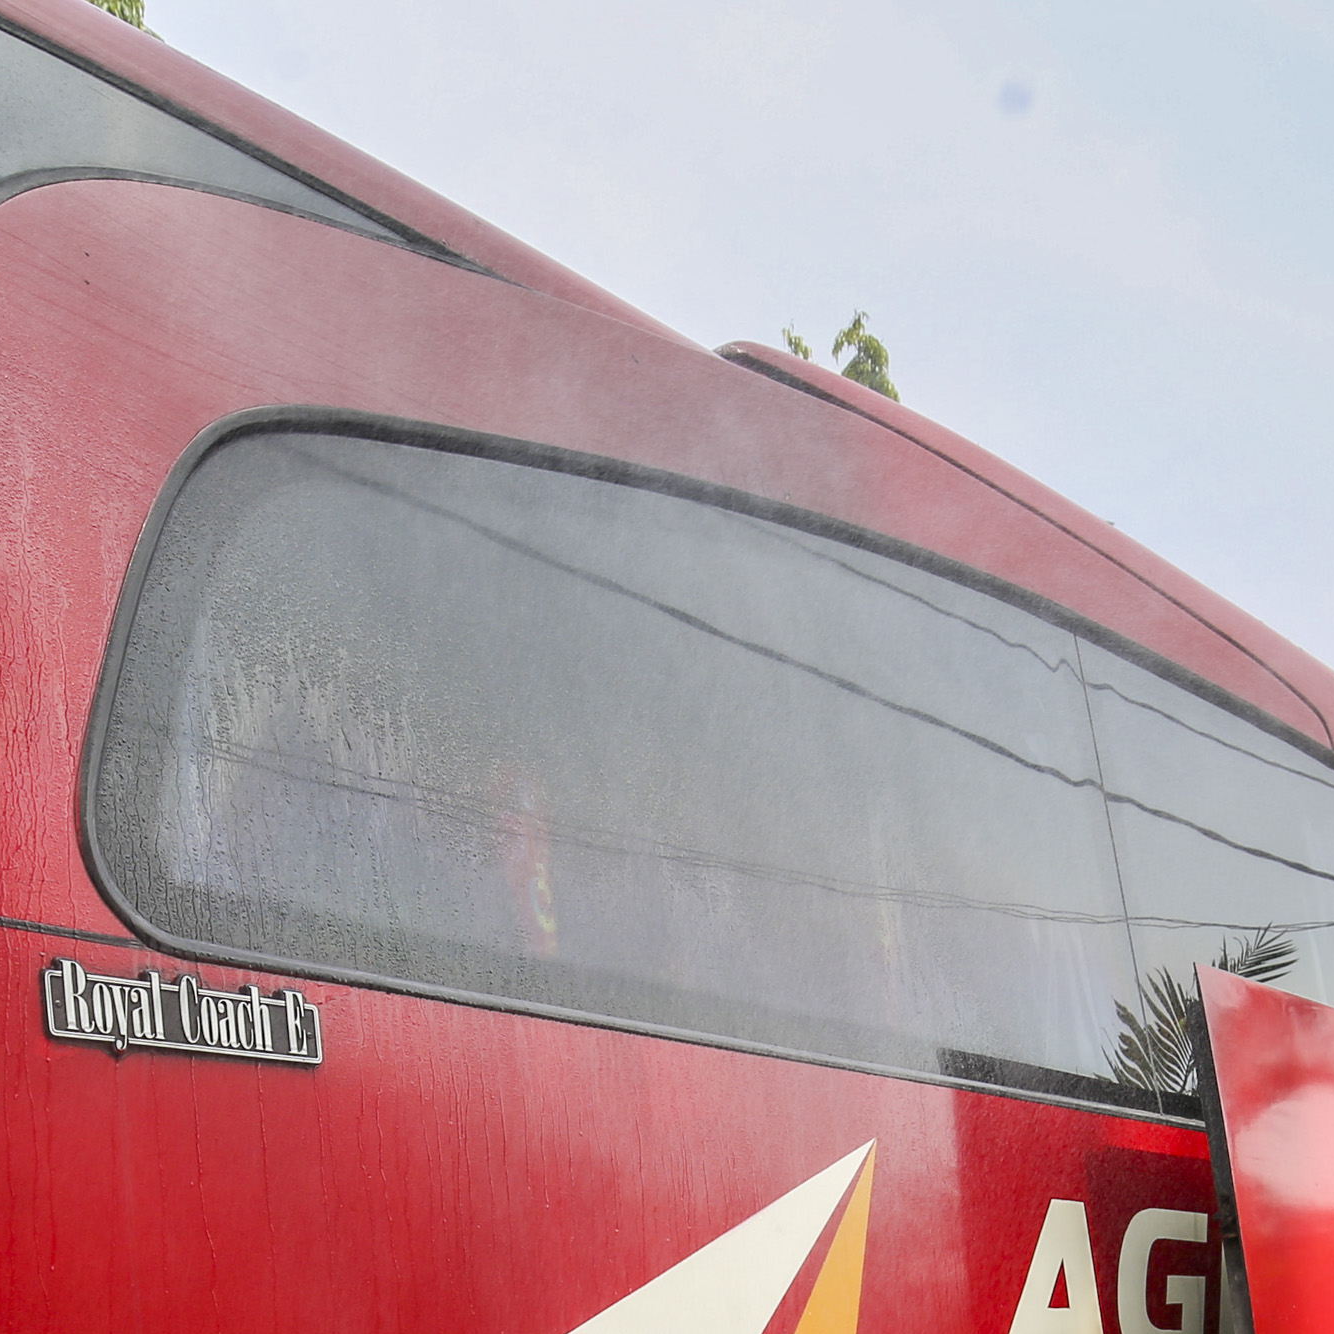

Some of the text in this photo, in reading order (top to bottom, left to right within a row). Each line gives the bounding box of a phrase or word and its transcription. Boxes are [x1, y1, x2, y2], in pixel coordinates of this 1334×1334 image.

[60, 958, 309, 1056] Royal Coach E
